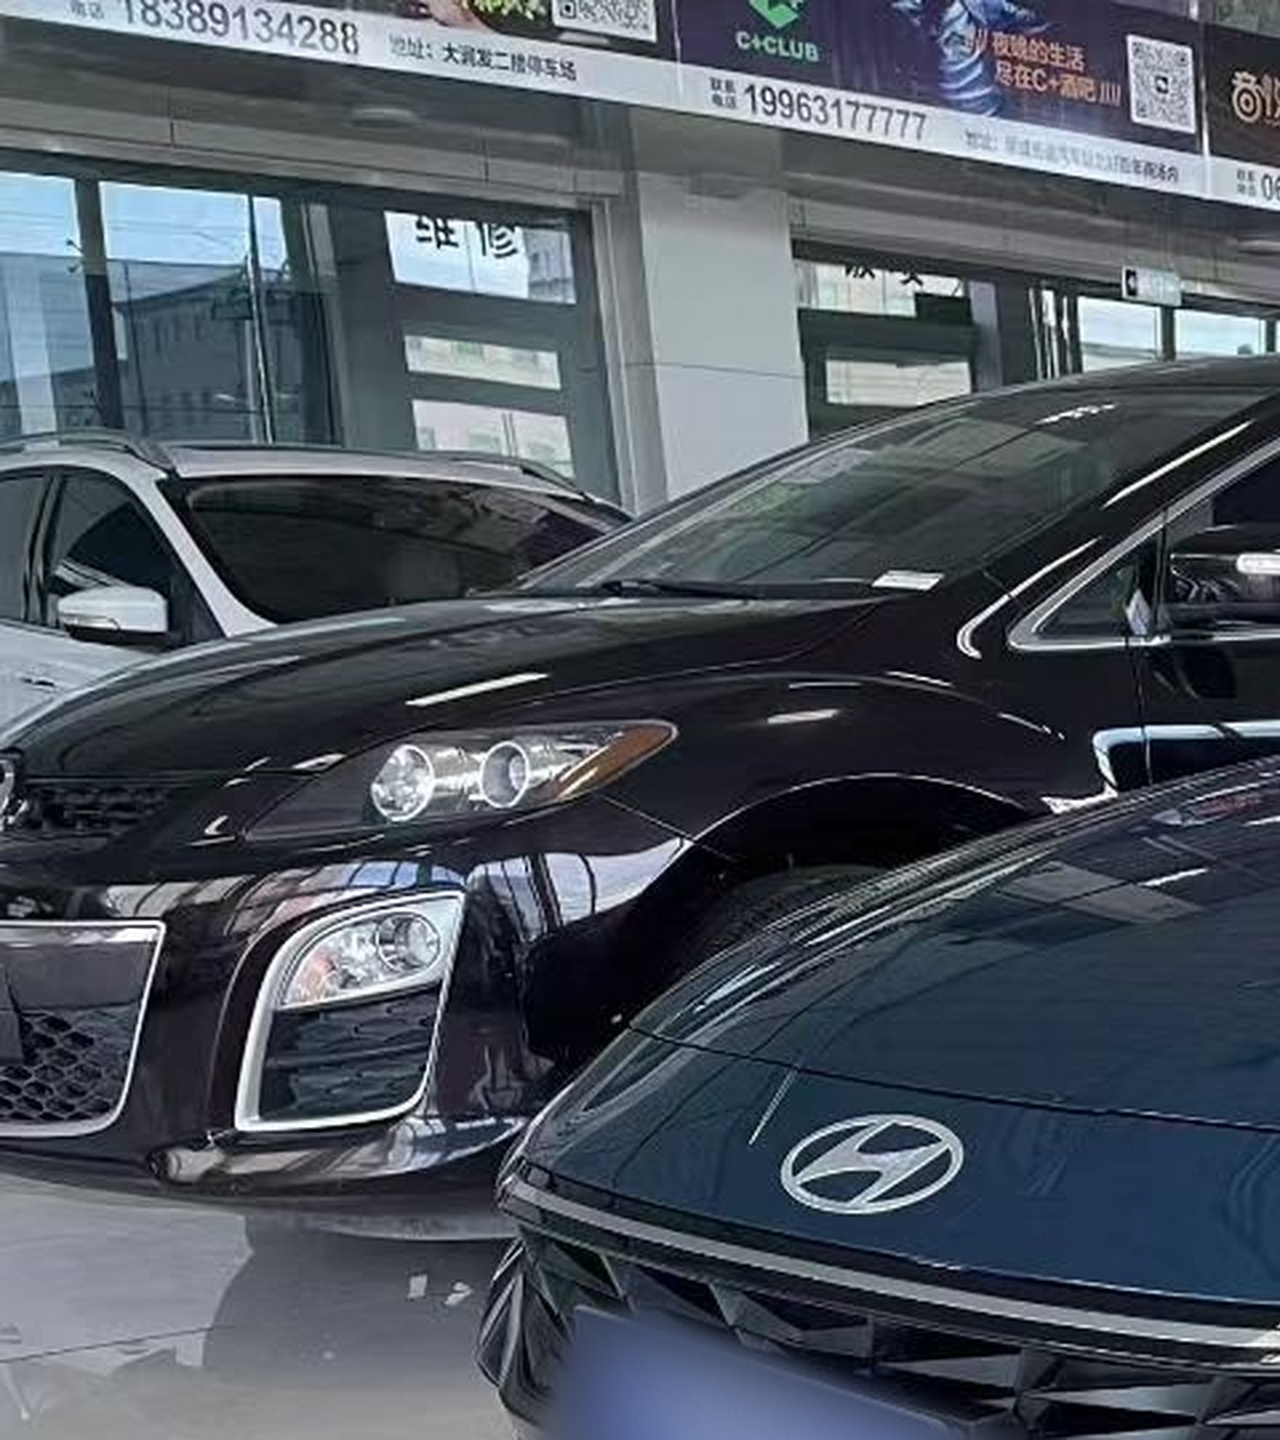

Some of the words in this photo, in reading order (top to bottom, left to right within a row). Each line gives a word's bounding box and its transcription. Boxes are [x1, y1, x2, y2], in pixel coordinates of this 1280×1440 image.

[122, 0, 361, 56] 18389134288
[735, 30, 821, 62] C+CLUB
[991, 31, 1086, 72] 夜晚的生活
[743, 84, 928, 141] 19963177777
